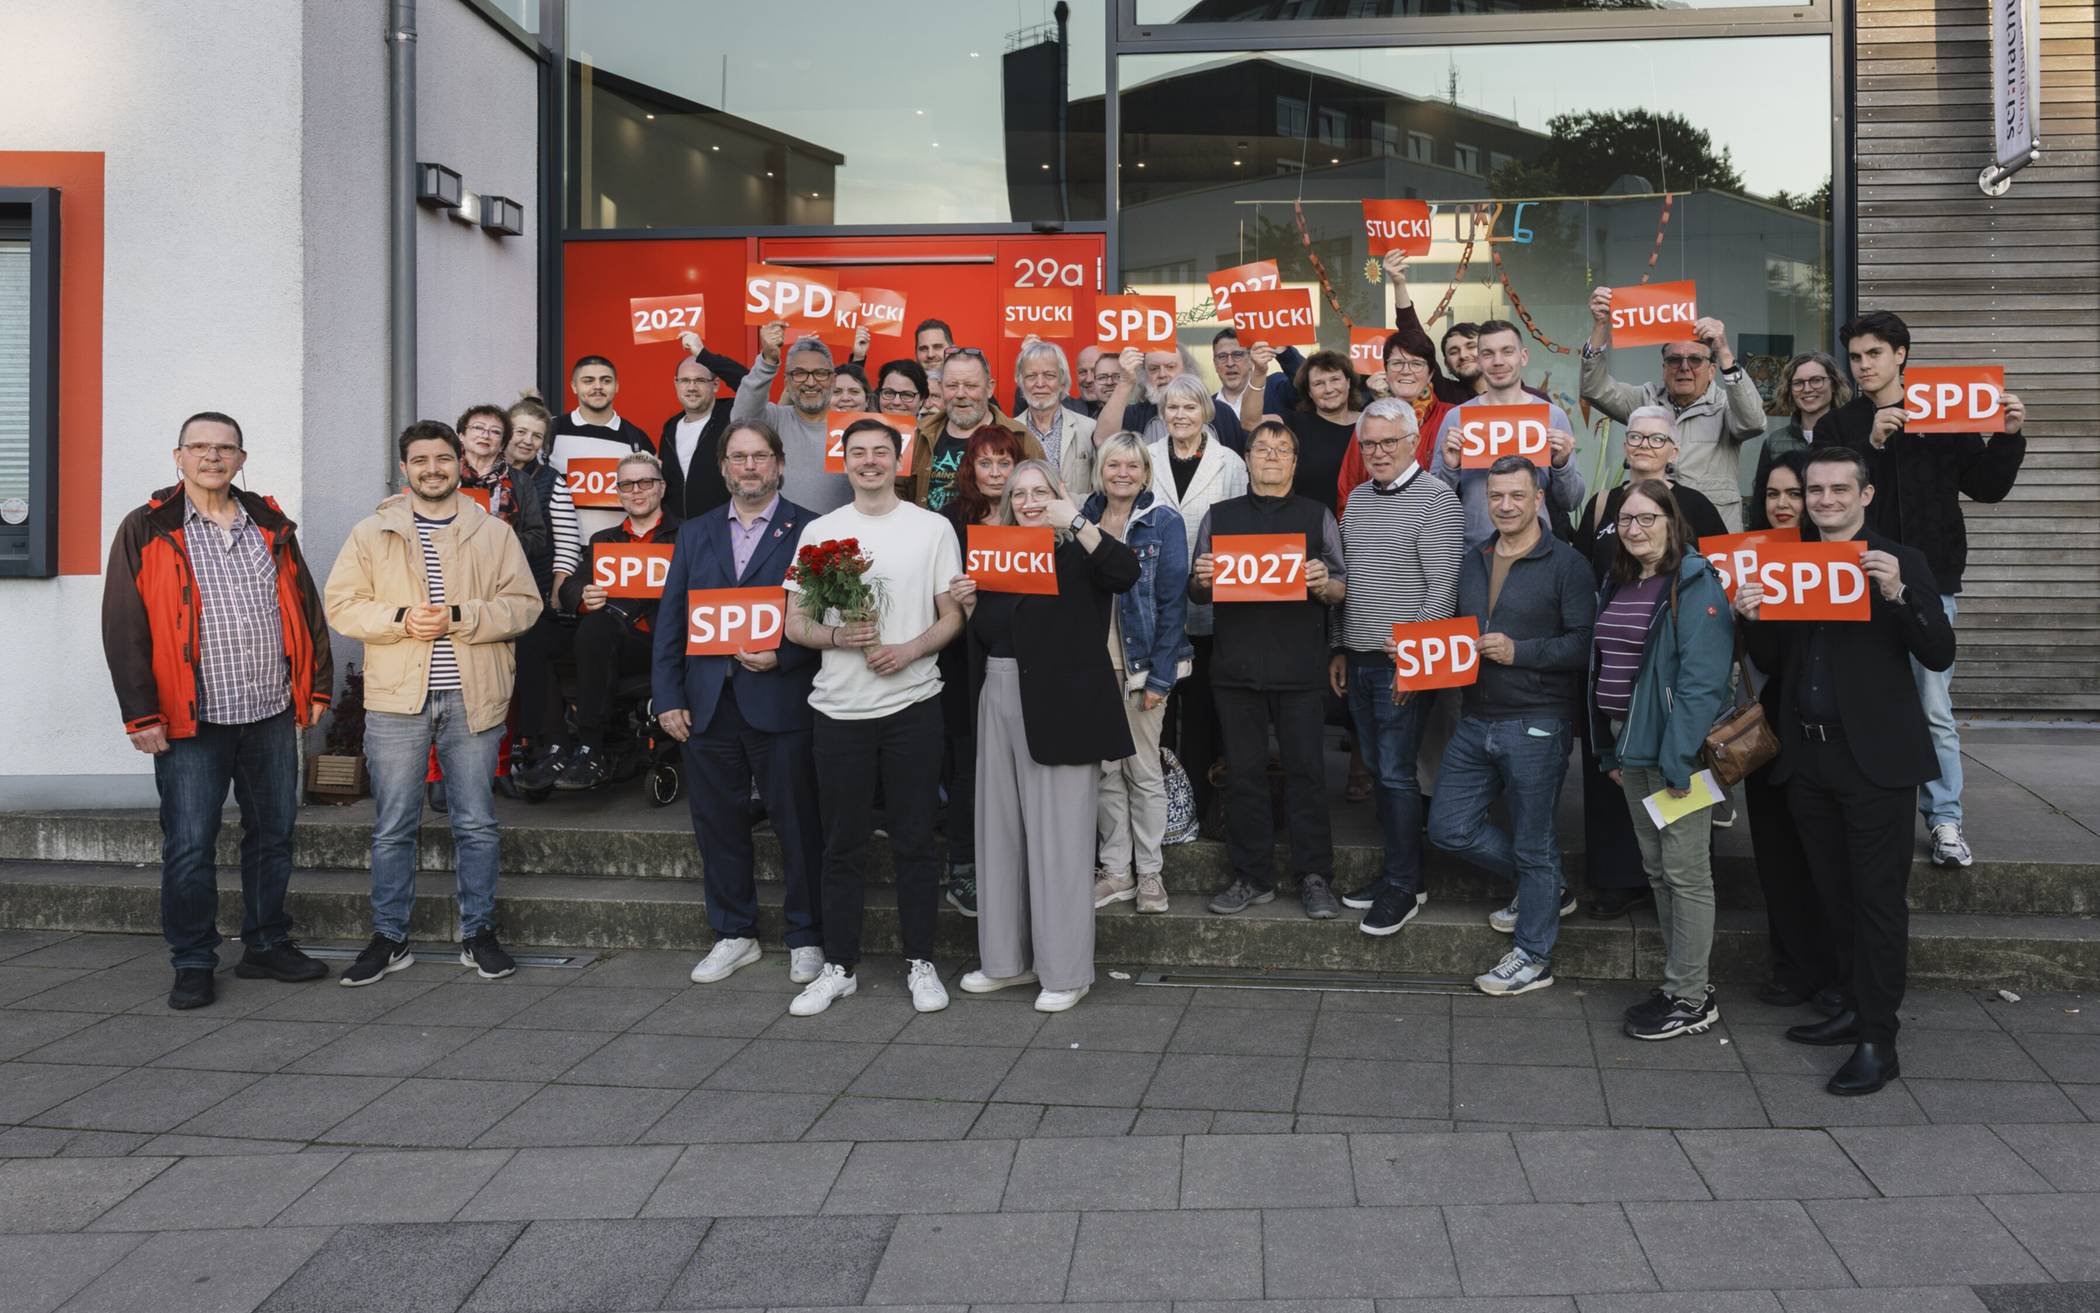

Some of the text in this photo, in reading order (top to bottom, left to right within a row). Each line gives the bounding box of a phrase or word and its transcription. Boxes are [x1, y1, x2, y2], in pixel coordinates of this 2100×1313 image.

[1366, 218, 1431, 239] STUCKI
[1014, 257, 1083, 288] 29a
[746, 278, 834, 318] SPD
[860, 303, 904, 323] UCKI
[1005, 304, 1073, 322] STUCKI
[633, 305, 703, 333] 2027
[1097, 308, 1174, 342] SPD
[1233, 306, 1313, 331] STUCKI
[1611, 301, 1696, 329] STUCKI
[1350, 343, 1384, 360] STU
[1906, 382, 2001, 421] SPD
[1462, 419, 1548, 457] SPD
[569, 470, 618, 495] 202
[594, 555, 671, 588] SPD
[967, 549, 1055, 575] STUCKI
[1215, 552, 1304, 586] 2027
[1706, 550, 1758, 591] SP
[1760, 561, 1866, 605] SPD
[689, 602, 783, 644] SPD
[1395, 634, 1478, 677] SPD
